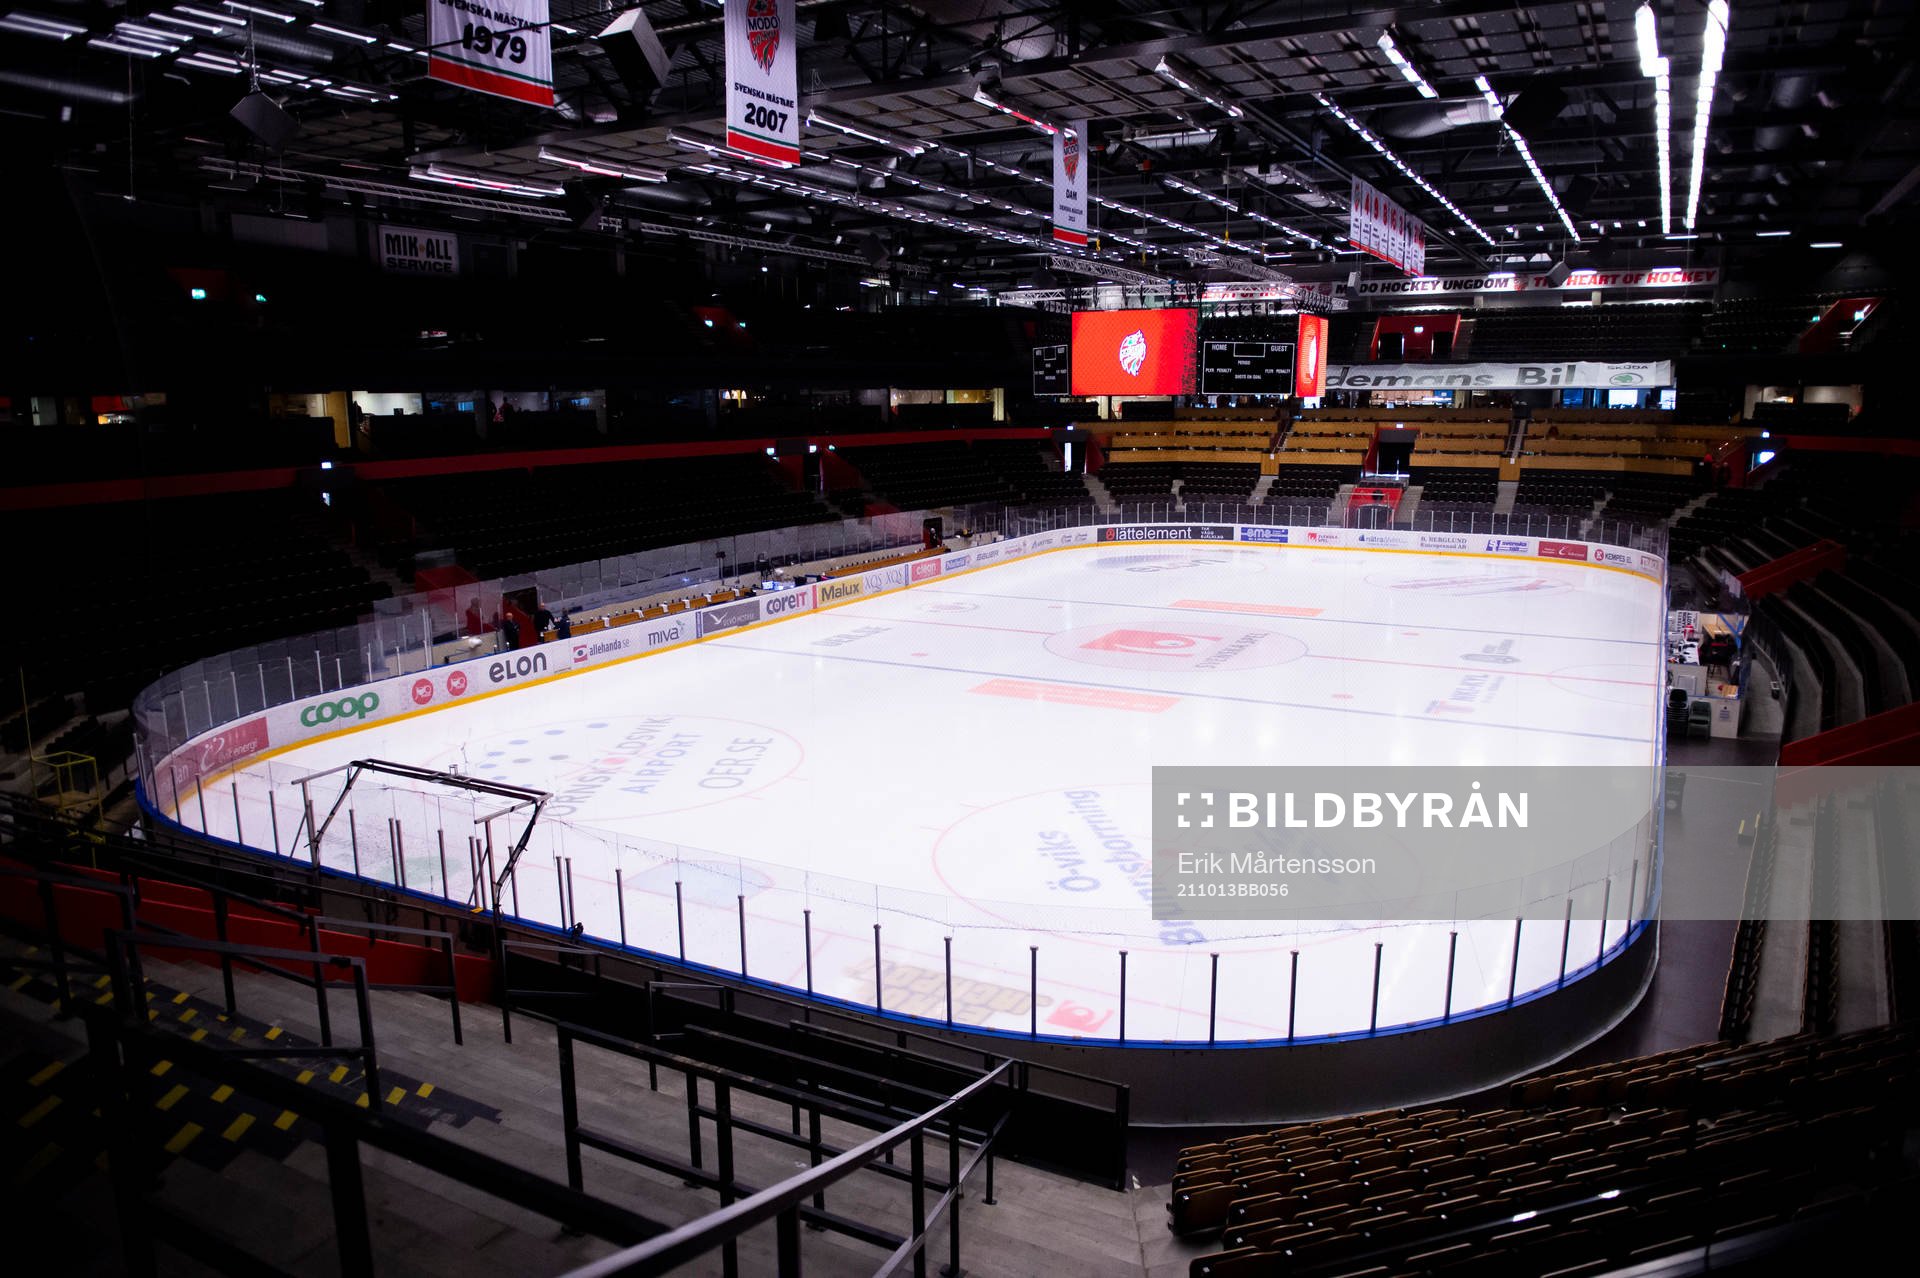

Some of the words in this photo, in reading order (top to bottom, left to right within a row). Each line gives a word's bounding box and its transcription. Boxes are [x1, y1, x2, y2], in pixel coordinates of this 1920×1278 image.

[747, 16, 779, 31] MODO
[462, 23, 527, 64] 1979
[734, 82, 766, 101] SVENSKA
[744, 102, 788, 133] 2007
[385, 233, 419, 257] MIK
[426, 238, 452, 260] ALL
[385, 257, 453, 273] SERVICE
[1335, 283, 1379, 295] MDO
[1380, 280, 1442, 293] HOCKEY
[1442, 278, 1509, 291] UNGDOM
[1566, 273, 1619, 286] HEART
[1622, 273, 1643, 284] OF
[1646, 270, 1716, 283] HOCKEY
[1516, 364, 1576, 387] Bil
[1115, 527, 1192, 540] lättelement
[1605, 553, 1626, 563] KEMPES
[766, 591, 808, 615] coreIT
[820, 582, 860, 601] Malux
[618, 732, 703, 794] AIRPORT
